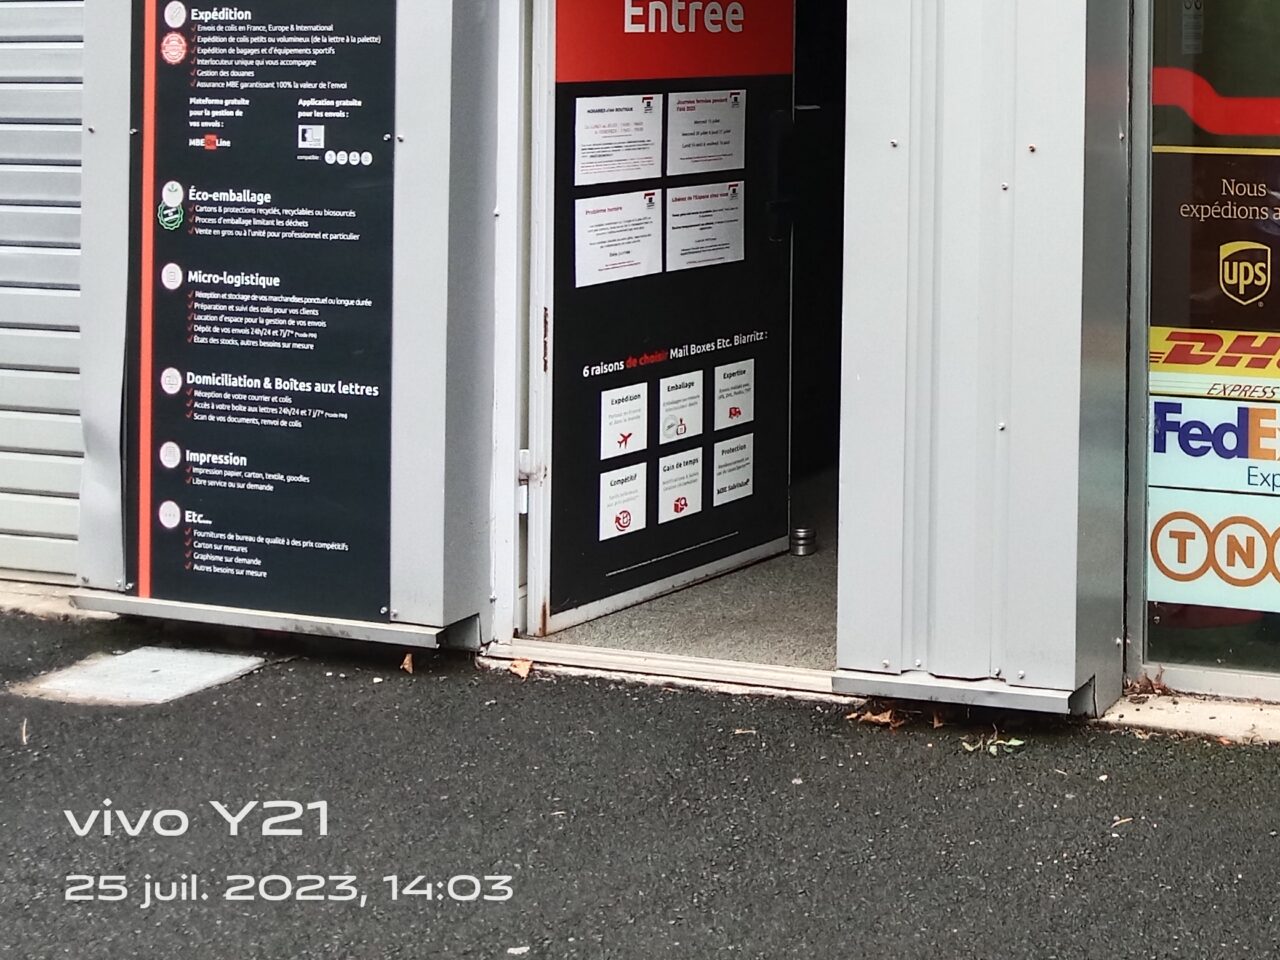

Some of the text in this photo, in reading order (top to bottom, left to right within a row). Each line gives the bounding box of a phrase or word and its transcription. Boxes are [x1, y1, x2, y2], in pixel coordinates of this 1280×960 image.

[191, 8, 251, 22] Expédition
[189, 186, 271, 205] Éco-emballage
[1221, 179, 1267, 196] Nous
[1180, 201, 1268, 222] expédions
[188, 271, 280, 288] Micro-logistique
[1224, 261, 1267, 294] ups
[583, 366, 589, 377] 6
[591, 360, 624, 375] raisons
[626, 356, 637, 368] de
[670, 345, 688, 359] Mail
[691, 341, 715, 355] Boxes
[717, 338, 732, 349] Etc.
[734, 331, 764, 346] Biarritz
[187, 372, 379, 396] Domiciliation & Boîtes aux lettres
[1207, 383, 1279, 399] EXPRESS
[186, 450, 247, 466] Impression
[247, 483, 273, 491] demande
[193, 541, 212, 549] Carton
